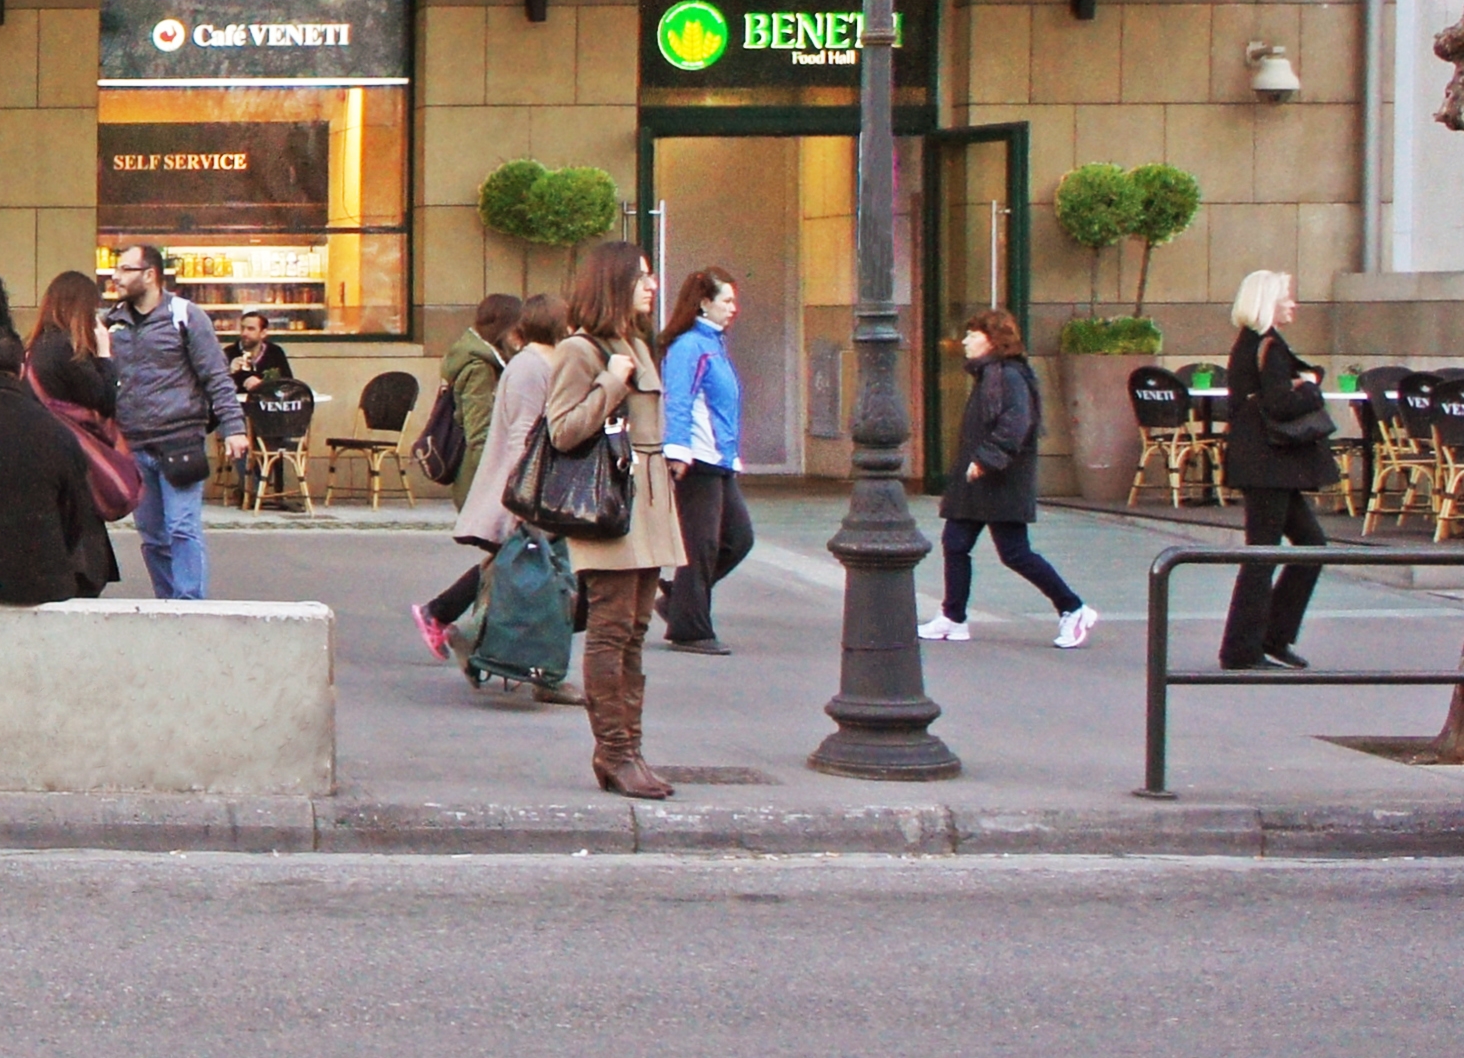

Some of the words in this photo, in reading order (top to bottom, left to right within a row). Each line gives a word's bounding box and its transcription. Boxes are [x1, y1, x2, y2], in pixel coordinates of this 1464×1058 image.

[192, 23, 247, 47] Café
[247, 23, 352, 46] VENETI
[791, 50, 826, 65] Food
[828, 49, 856, 64] Hall
[113, 154, 161, 170] SELF
[163, 153, 248, 170] SERVICE
[1135, 390, 1175, 401] VENETI
[1406, 396, 1431, 409] VEN
[259, 400, 302, 412] VENETI
